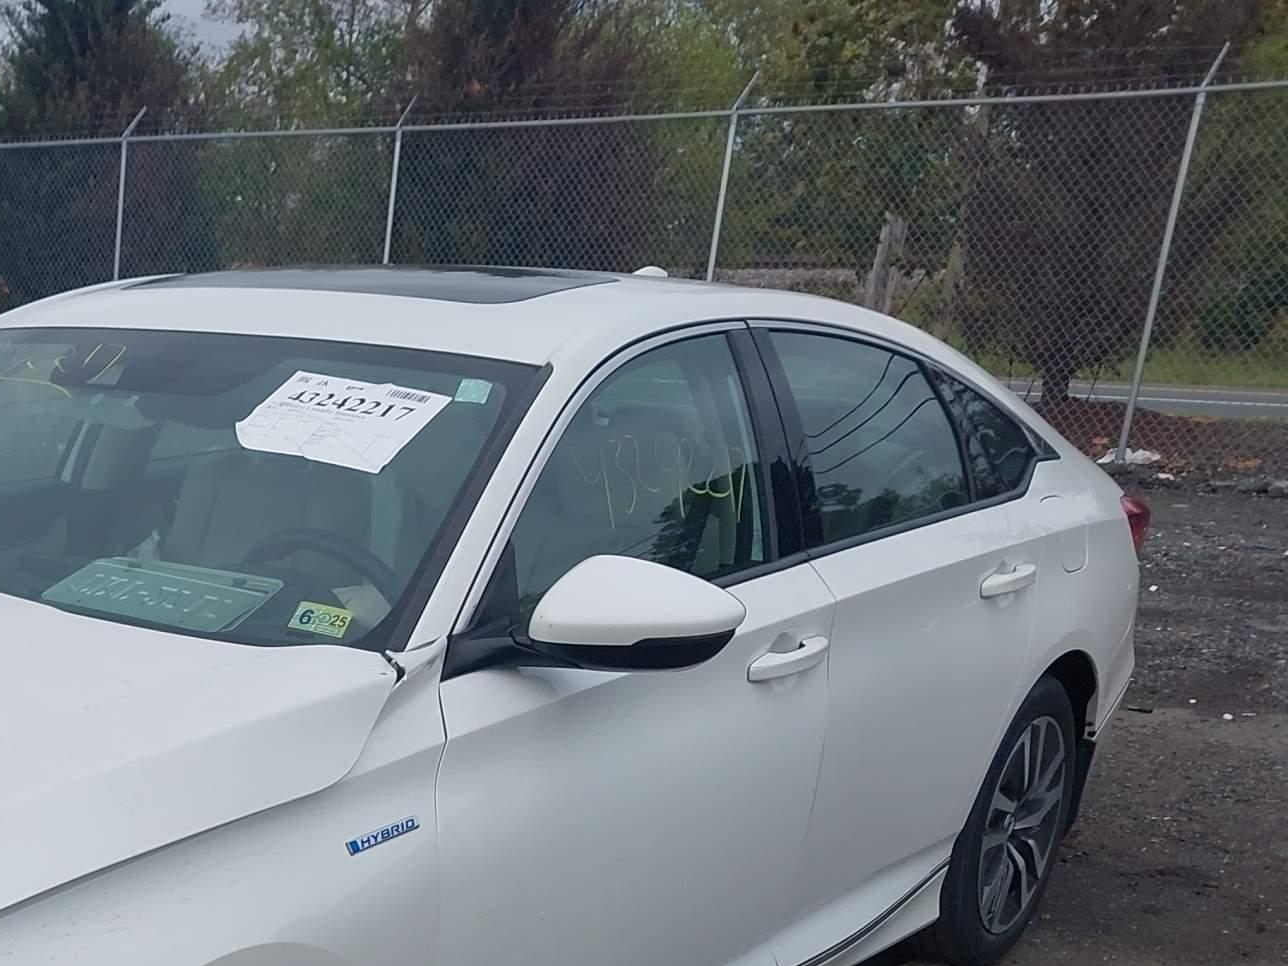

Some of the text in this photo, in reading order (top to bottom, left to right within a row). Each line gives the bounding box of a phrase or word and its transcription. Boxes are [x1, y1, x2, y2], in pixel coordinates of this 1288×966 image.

[288, 390, 416, 421] 43242217
[299, 609, 349, 628] 6 25
[360, 818, 416, 848] HYBRID
